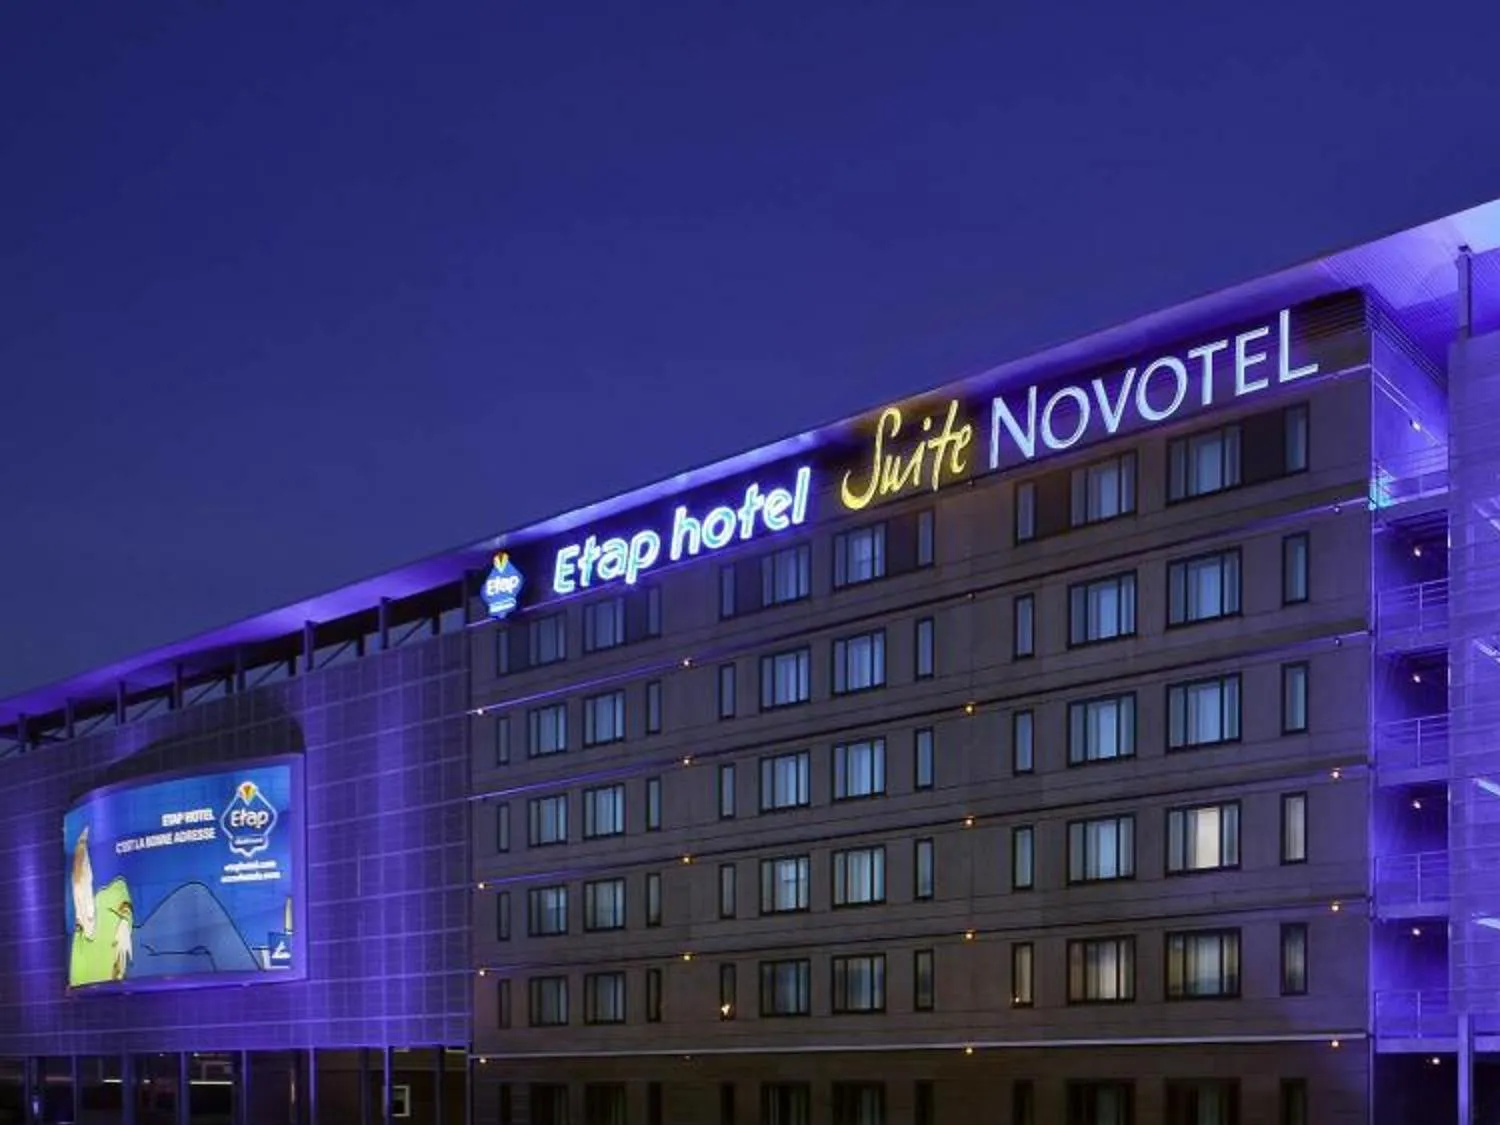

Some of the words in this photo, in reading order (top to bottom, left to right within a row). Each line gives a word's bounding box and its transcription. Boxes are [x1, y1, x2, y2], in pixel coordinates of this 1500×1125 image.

[840, 400, 974, 511] Suite
[988, 308, 1320, 470] NOVOTEL
[553, 530, 661, 594] Etap
[669, 465, 812, 561] hotel
[230, 809, 269, 828] Etap
